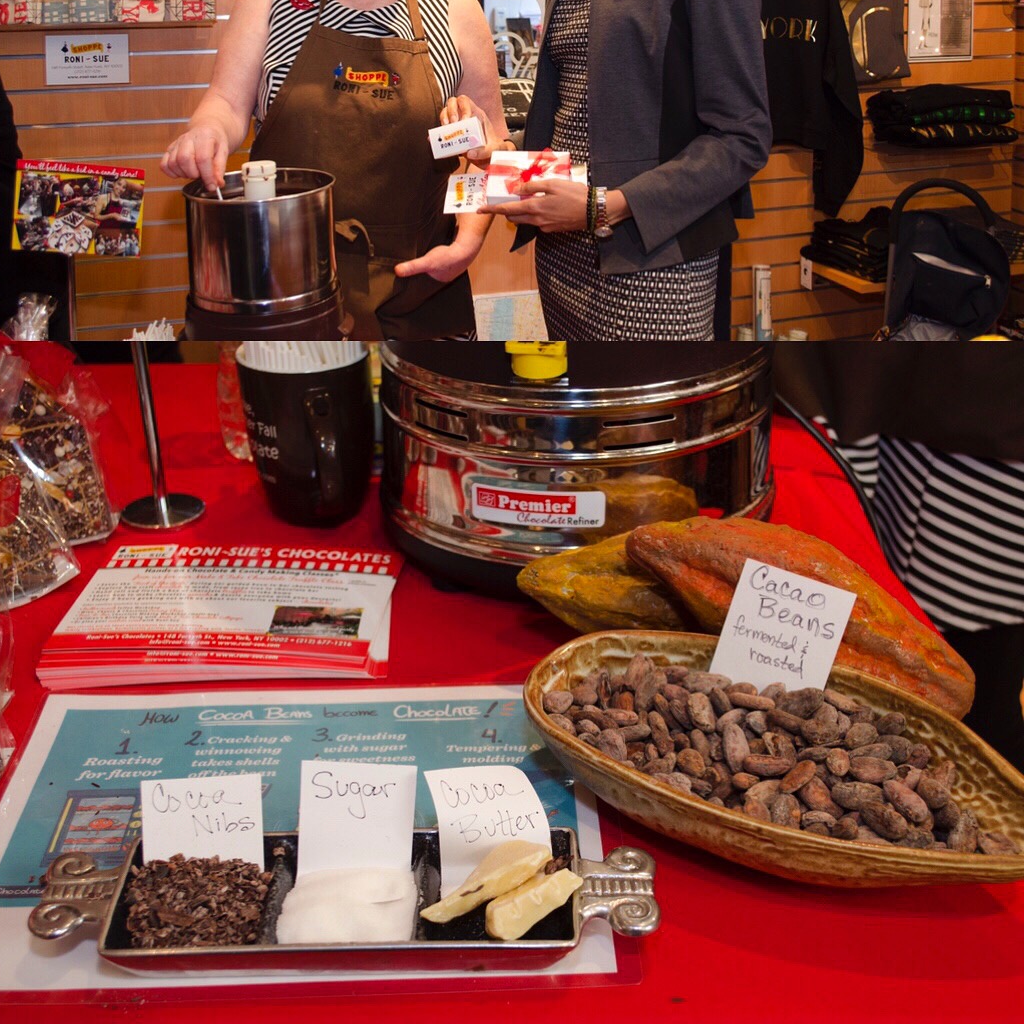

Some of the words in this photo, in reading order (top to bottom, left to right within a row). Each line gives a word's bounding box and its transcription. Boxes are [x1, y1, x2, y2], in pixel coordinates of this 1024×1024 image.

[72, 43, 103, 53] SHOPPE
[93, 55, 110, 63] SUE
[348, 73, 387, 82] SHOPPE
[333, 80, 361, 94] RONI
[371, 88, 395, 100] SUE
[441, 141, 454, 149] RONI
[46, 163, 58, 172] feel
[76, 165, 86, 173] kid
[100, 168, 119, 179] candy
[257, 422, 277, 438] Fall
[498, 494, 571, 513] Premier
[517, 512, 566, 525] Chocolate
[567, 517, 599, 525] Refiner
[276, 548, 392, 564] CHOCOLATES
[750, 565, 826, 609] Cacao
[758, 594, 835, 640] Beans
[733, 615, 798, 653] fermented
[749, 647, 804, 679] roasted
[207, 734, 278, 746] Cracking
[279, 735, 293, 744] &
[336, 732, 407, 743] Grinding
[195, 746, 282, 756] winnowing
[324, 744, 358, 753] with
[362, 744, 407, 754] sugar
[446, 743, 527, 754] Tempering
[529, 744, 541, 752] &
[83, 756, 163, 768] Roasting
[191, 758, 232, 767] takes
[235, 756, 280, 766] shells
[339, 754, 416, 763] sweetness
[463, 754, 525, 764] molding
[75, 769, 105, 781] for
[105, 768, 162, 780] flavor
[151, 782, 242, 813] Cocoa
[312, 771, 396, 819] Sugar
[440, 780, 525, 808] Cocoa
[191, 812, 256, 837] Nibs
[450, 810, 540, 844] Butter
